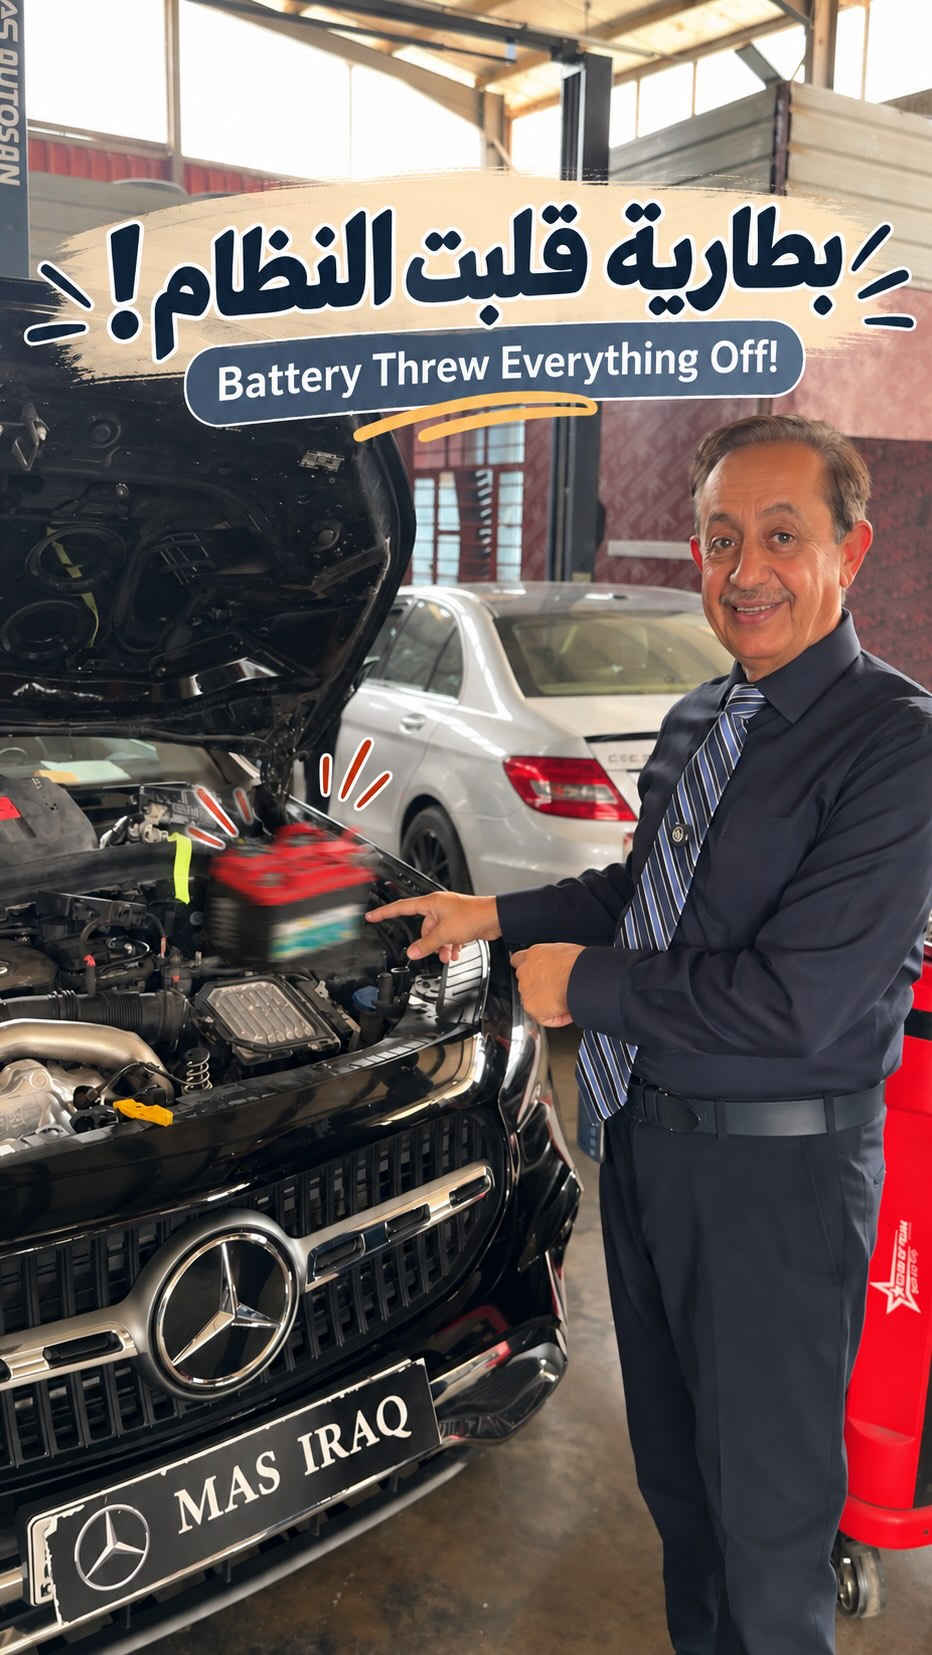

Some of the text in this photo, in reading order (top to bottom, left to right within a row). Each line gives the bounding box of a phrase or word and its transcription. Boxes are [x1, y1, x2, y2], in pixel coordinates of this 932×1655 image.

[0, 47, 20, 186] AUTOSAN
[173, 1395, 413, 1535] MAS IRAQ
